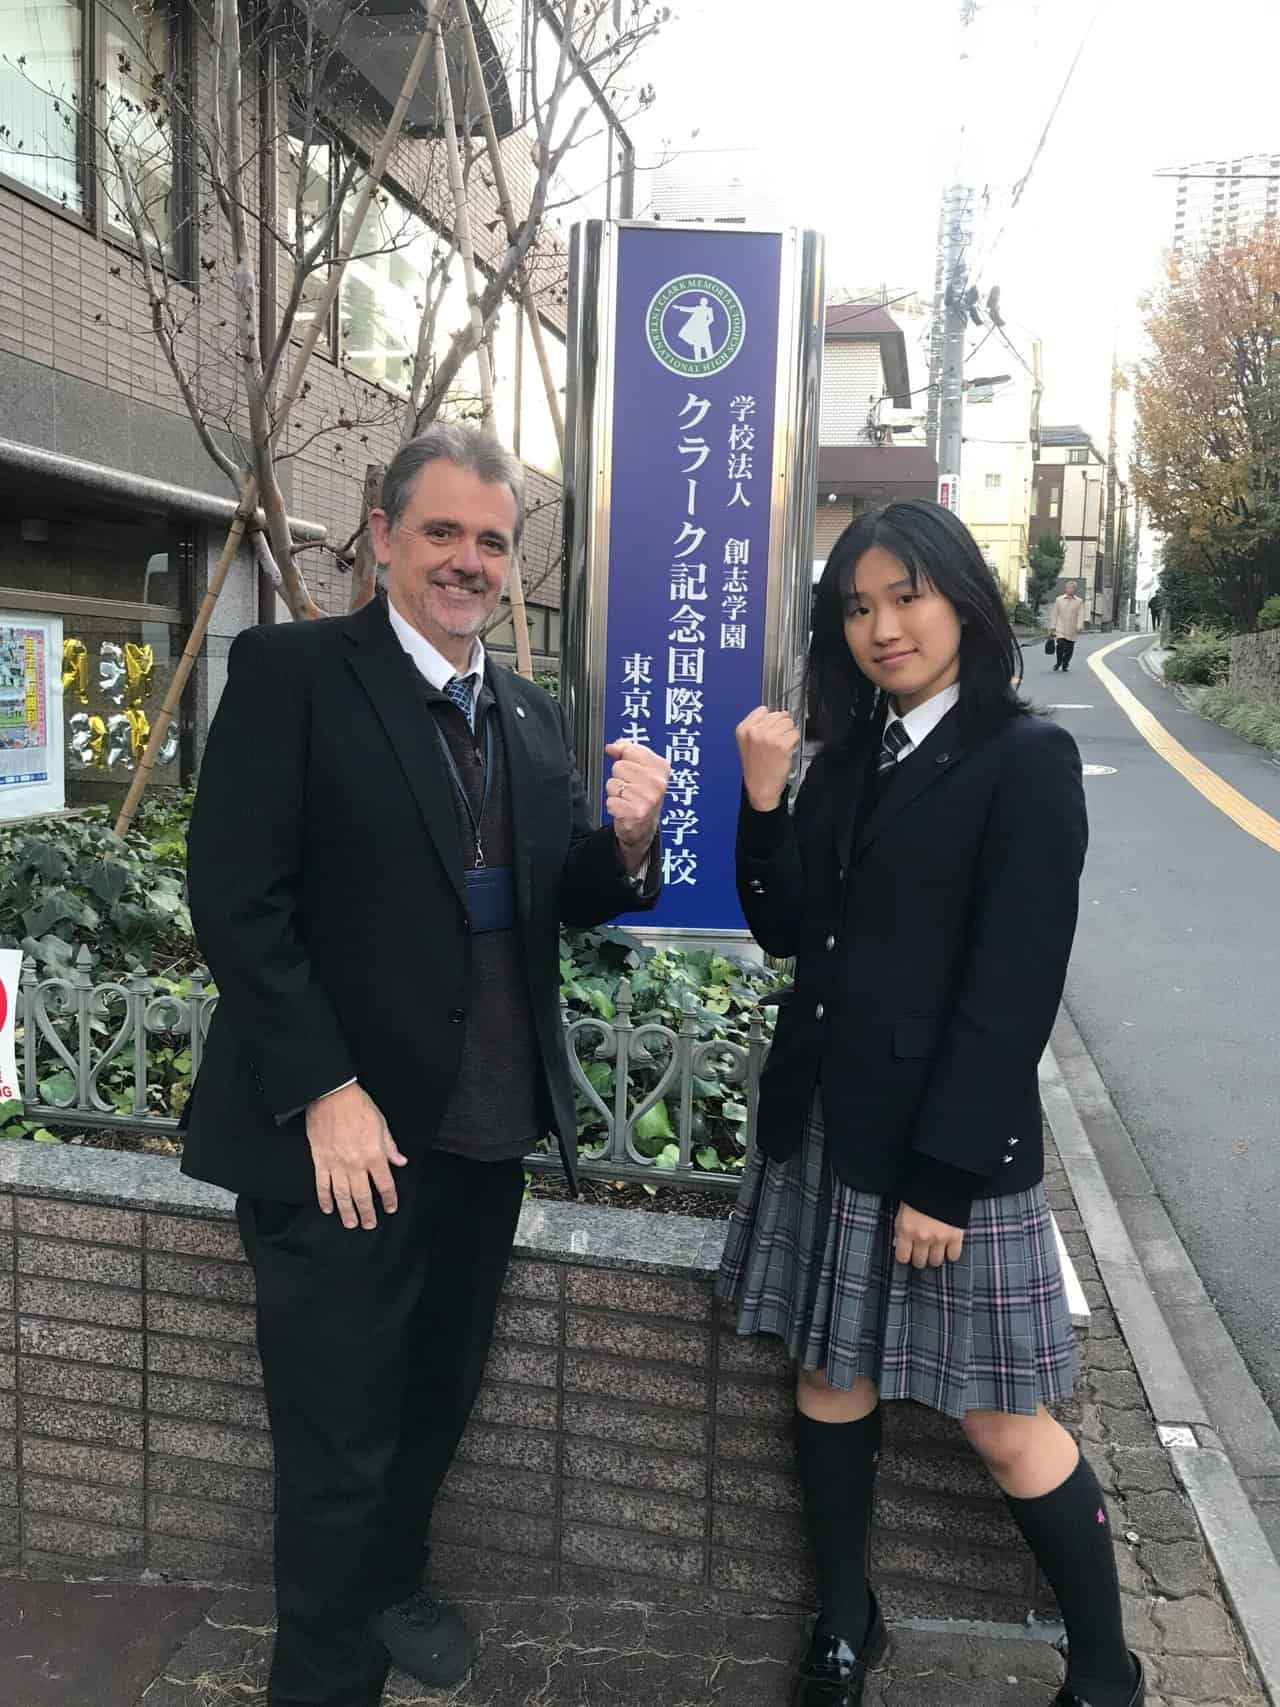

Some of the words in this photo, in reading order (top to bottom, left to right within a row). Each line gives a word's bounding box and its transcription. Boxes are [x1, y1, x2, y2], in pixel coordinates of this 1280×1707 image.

[658, 282, 686, 306] CLARK
[727, 395, 756, 508] 学校法人
[661, 392, 711, 886] クラーク記念国際高等学校
[720, 538, 750, 649] 創志学園
